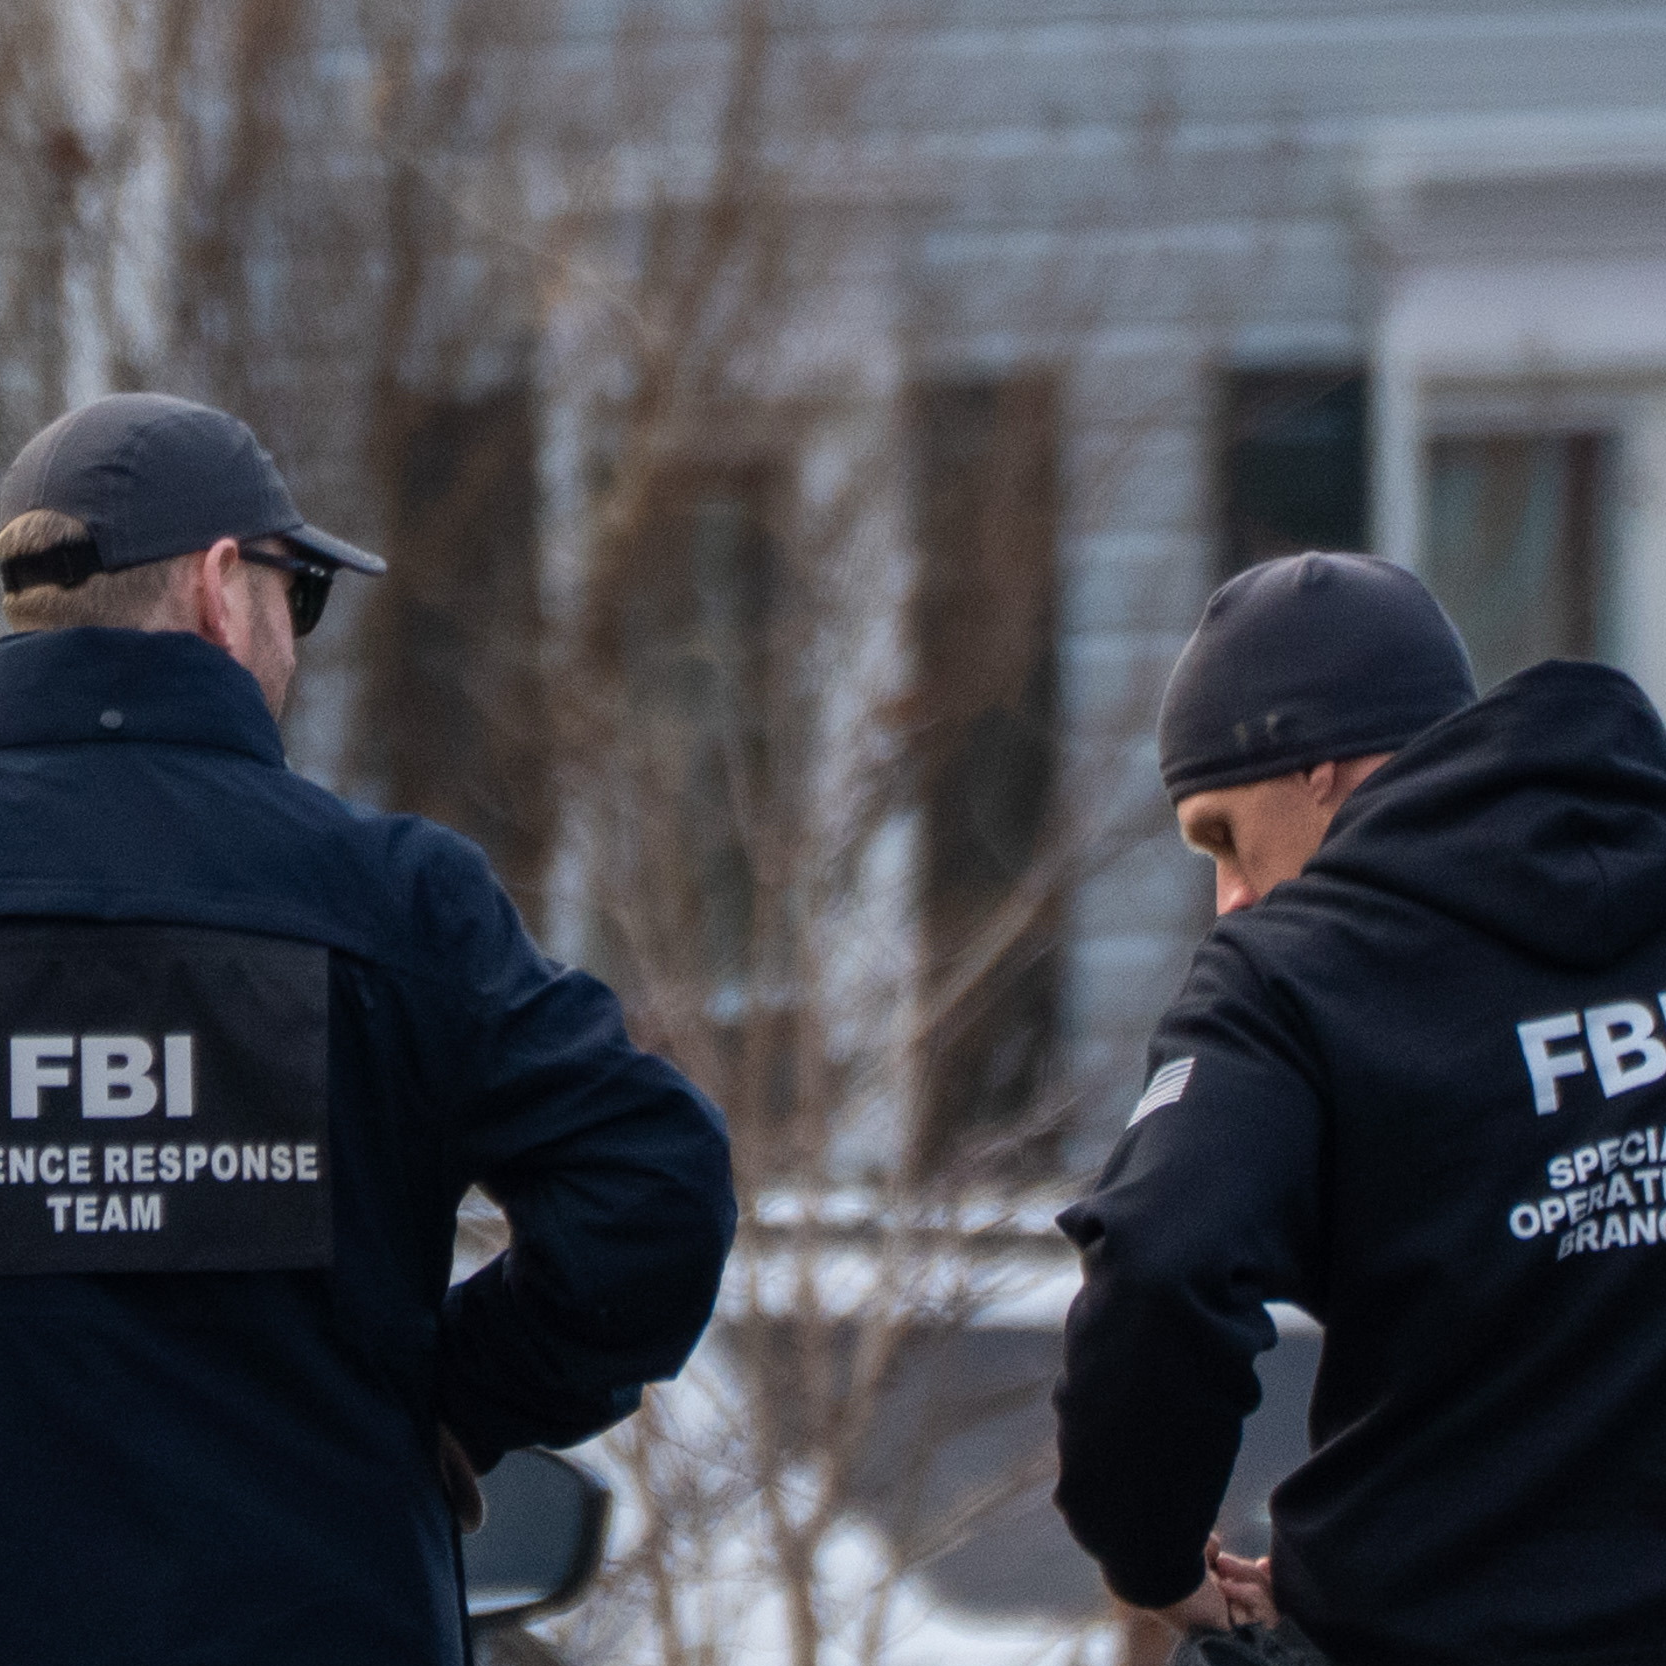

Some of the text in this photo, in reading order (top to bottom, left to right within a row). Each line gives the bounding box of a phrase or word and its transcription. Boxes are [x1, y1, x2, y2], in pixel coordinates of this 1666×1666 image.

[9, 1033, 195, 1119] FBI
[103, 1142, 319, 1183] RESPONSE
[46, 1193, 164, 1233] TEAM
